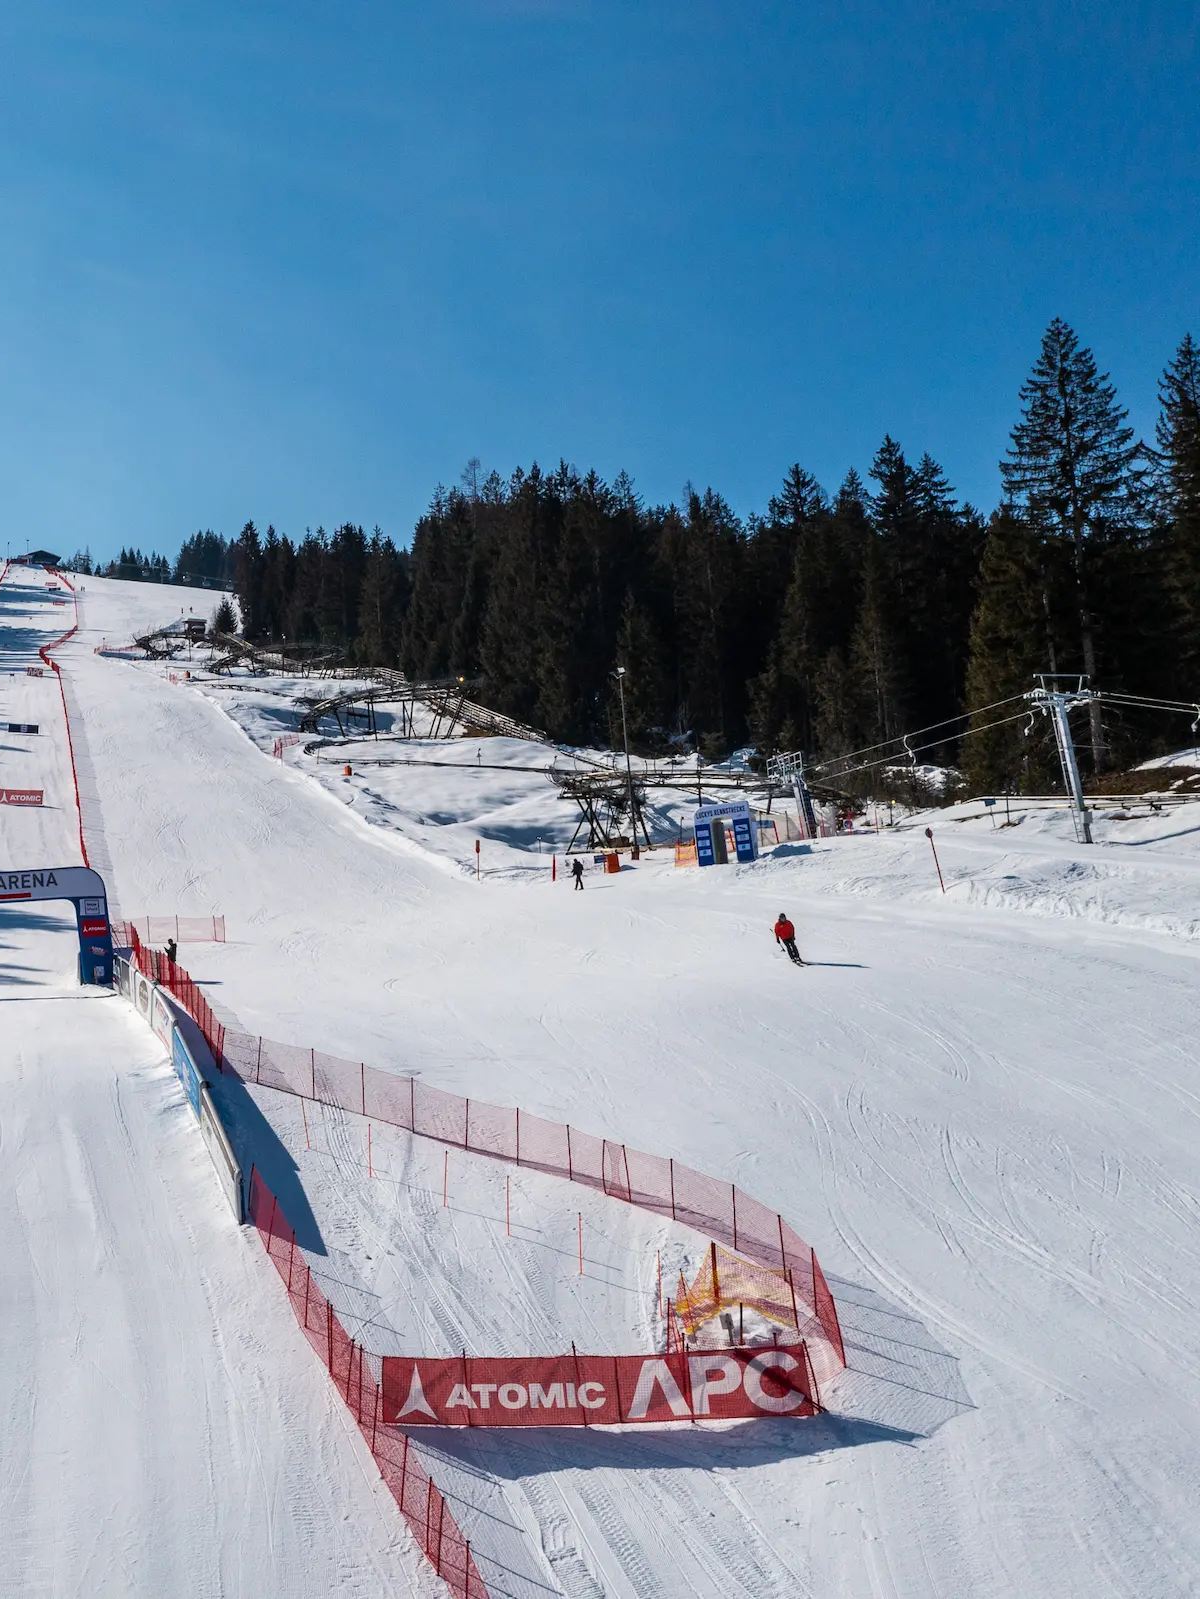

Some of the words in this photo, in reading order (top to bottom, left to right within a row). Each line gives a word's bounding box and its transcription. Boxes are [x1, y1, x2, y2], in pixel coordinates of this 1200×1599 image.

[9, 794, 41, 802] ATOMIC
[445, 1382, 606, 1409] ATOMIC
[627, 1351, 803, 1419] APC
